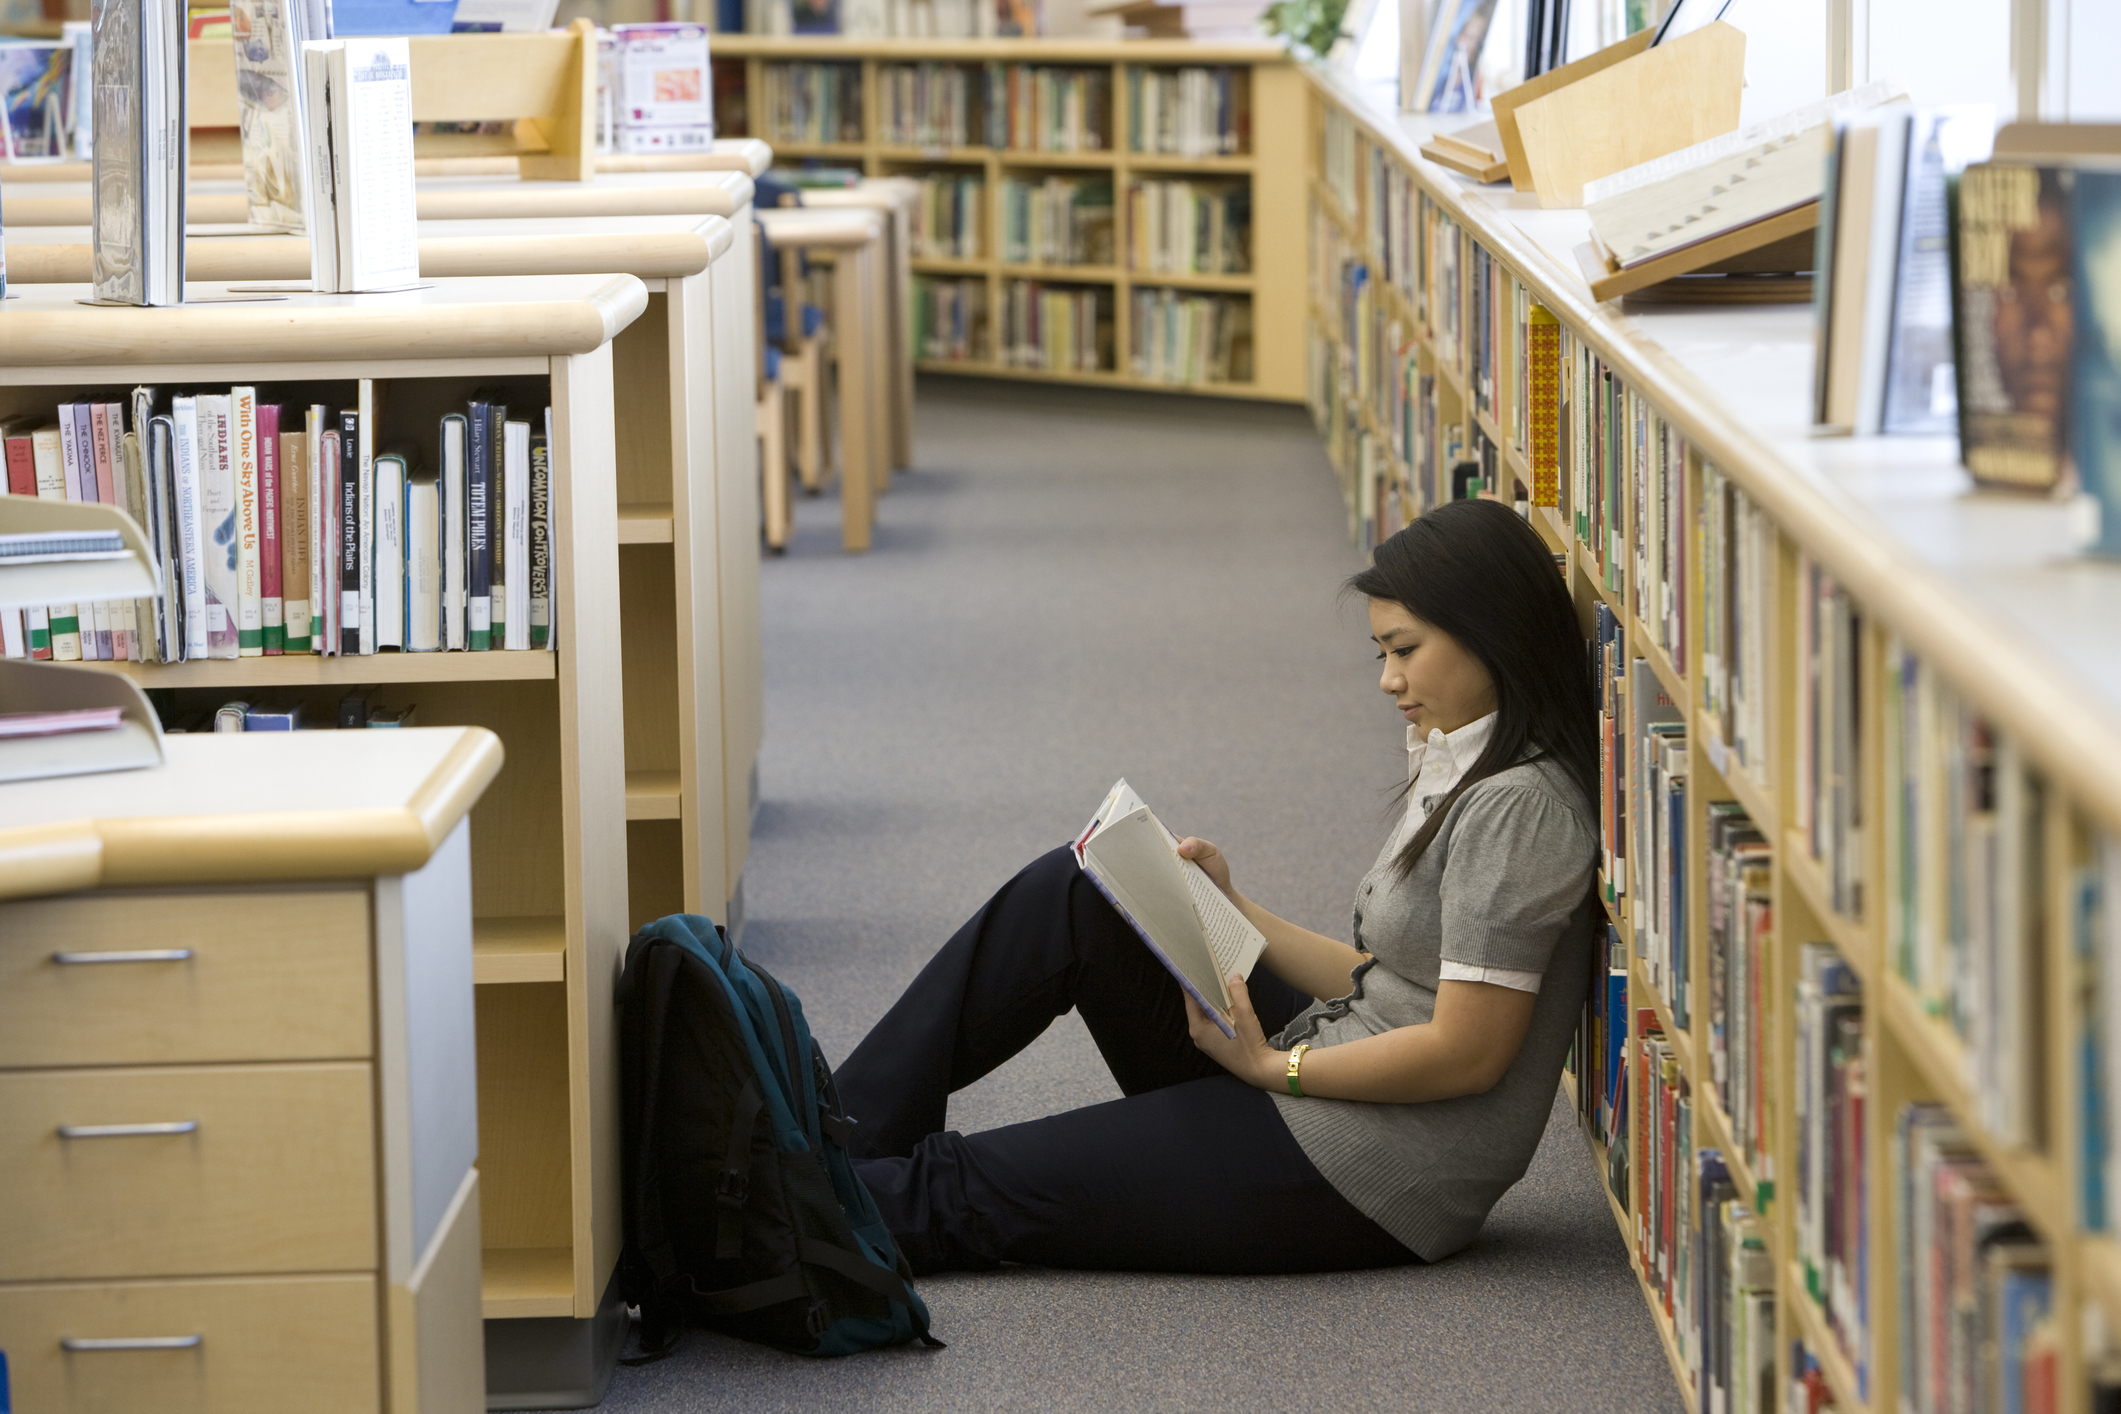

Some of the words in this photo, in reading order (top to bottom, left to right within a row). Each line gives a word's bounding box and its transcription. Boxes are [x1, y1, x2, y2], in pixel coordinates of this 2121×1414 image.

[240, 395, 252, 427] With
[207, 419, 216, 432] the
[473, 419, 482, 444] Hilary
[114, 429, 122, 463] KWAKIUTL
[180, 438, 190, 474] INDIANS
[217, 414, 228, 471] INDIANS
[241, 430, 252, 458] One
[264, 437, 273, 455] INDIAN
[82, 440, 91, 474] CHINOOK
[265, 456, 273, 471] WARS
[240, 462, 253, 488] Sky
[532, 447, 548, 519] UNCOMMON
[242, 488, 255, 531] Above
[265, 488, 274, 508] PACIFIC
[345, 482, 354, 514] Indians
[471, 482, 486, 517] TOTEM
[182, 487, 194, 554] NORTHEASTERN
[266, 509, 275, 539] NORTHWEST
[296, 497, 306, 536] INDIAN
[345, 516, 355, 525] of
[363, 520, 369, 529] An
[244, 534, 255, 550] Us
[345, 527, 355, 542] the
[471, 520, 486, 550] POLES
[246, 560, 253, 568] M
[297, 540, 306, 564] LIFE
[345, 543, 356, 570] Plains
[532, 520, 548, 600] CONTROVERSY
[186, 557, 197, 596] AMERICA
[245, 569, 254, 596] Gidley
[362, 566, 370, 589] Colony
